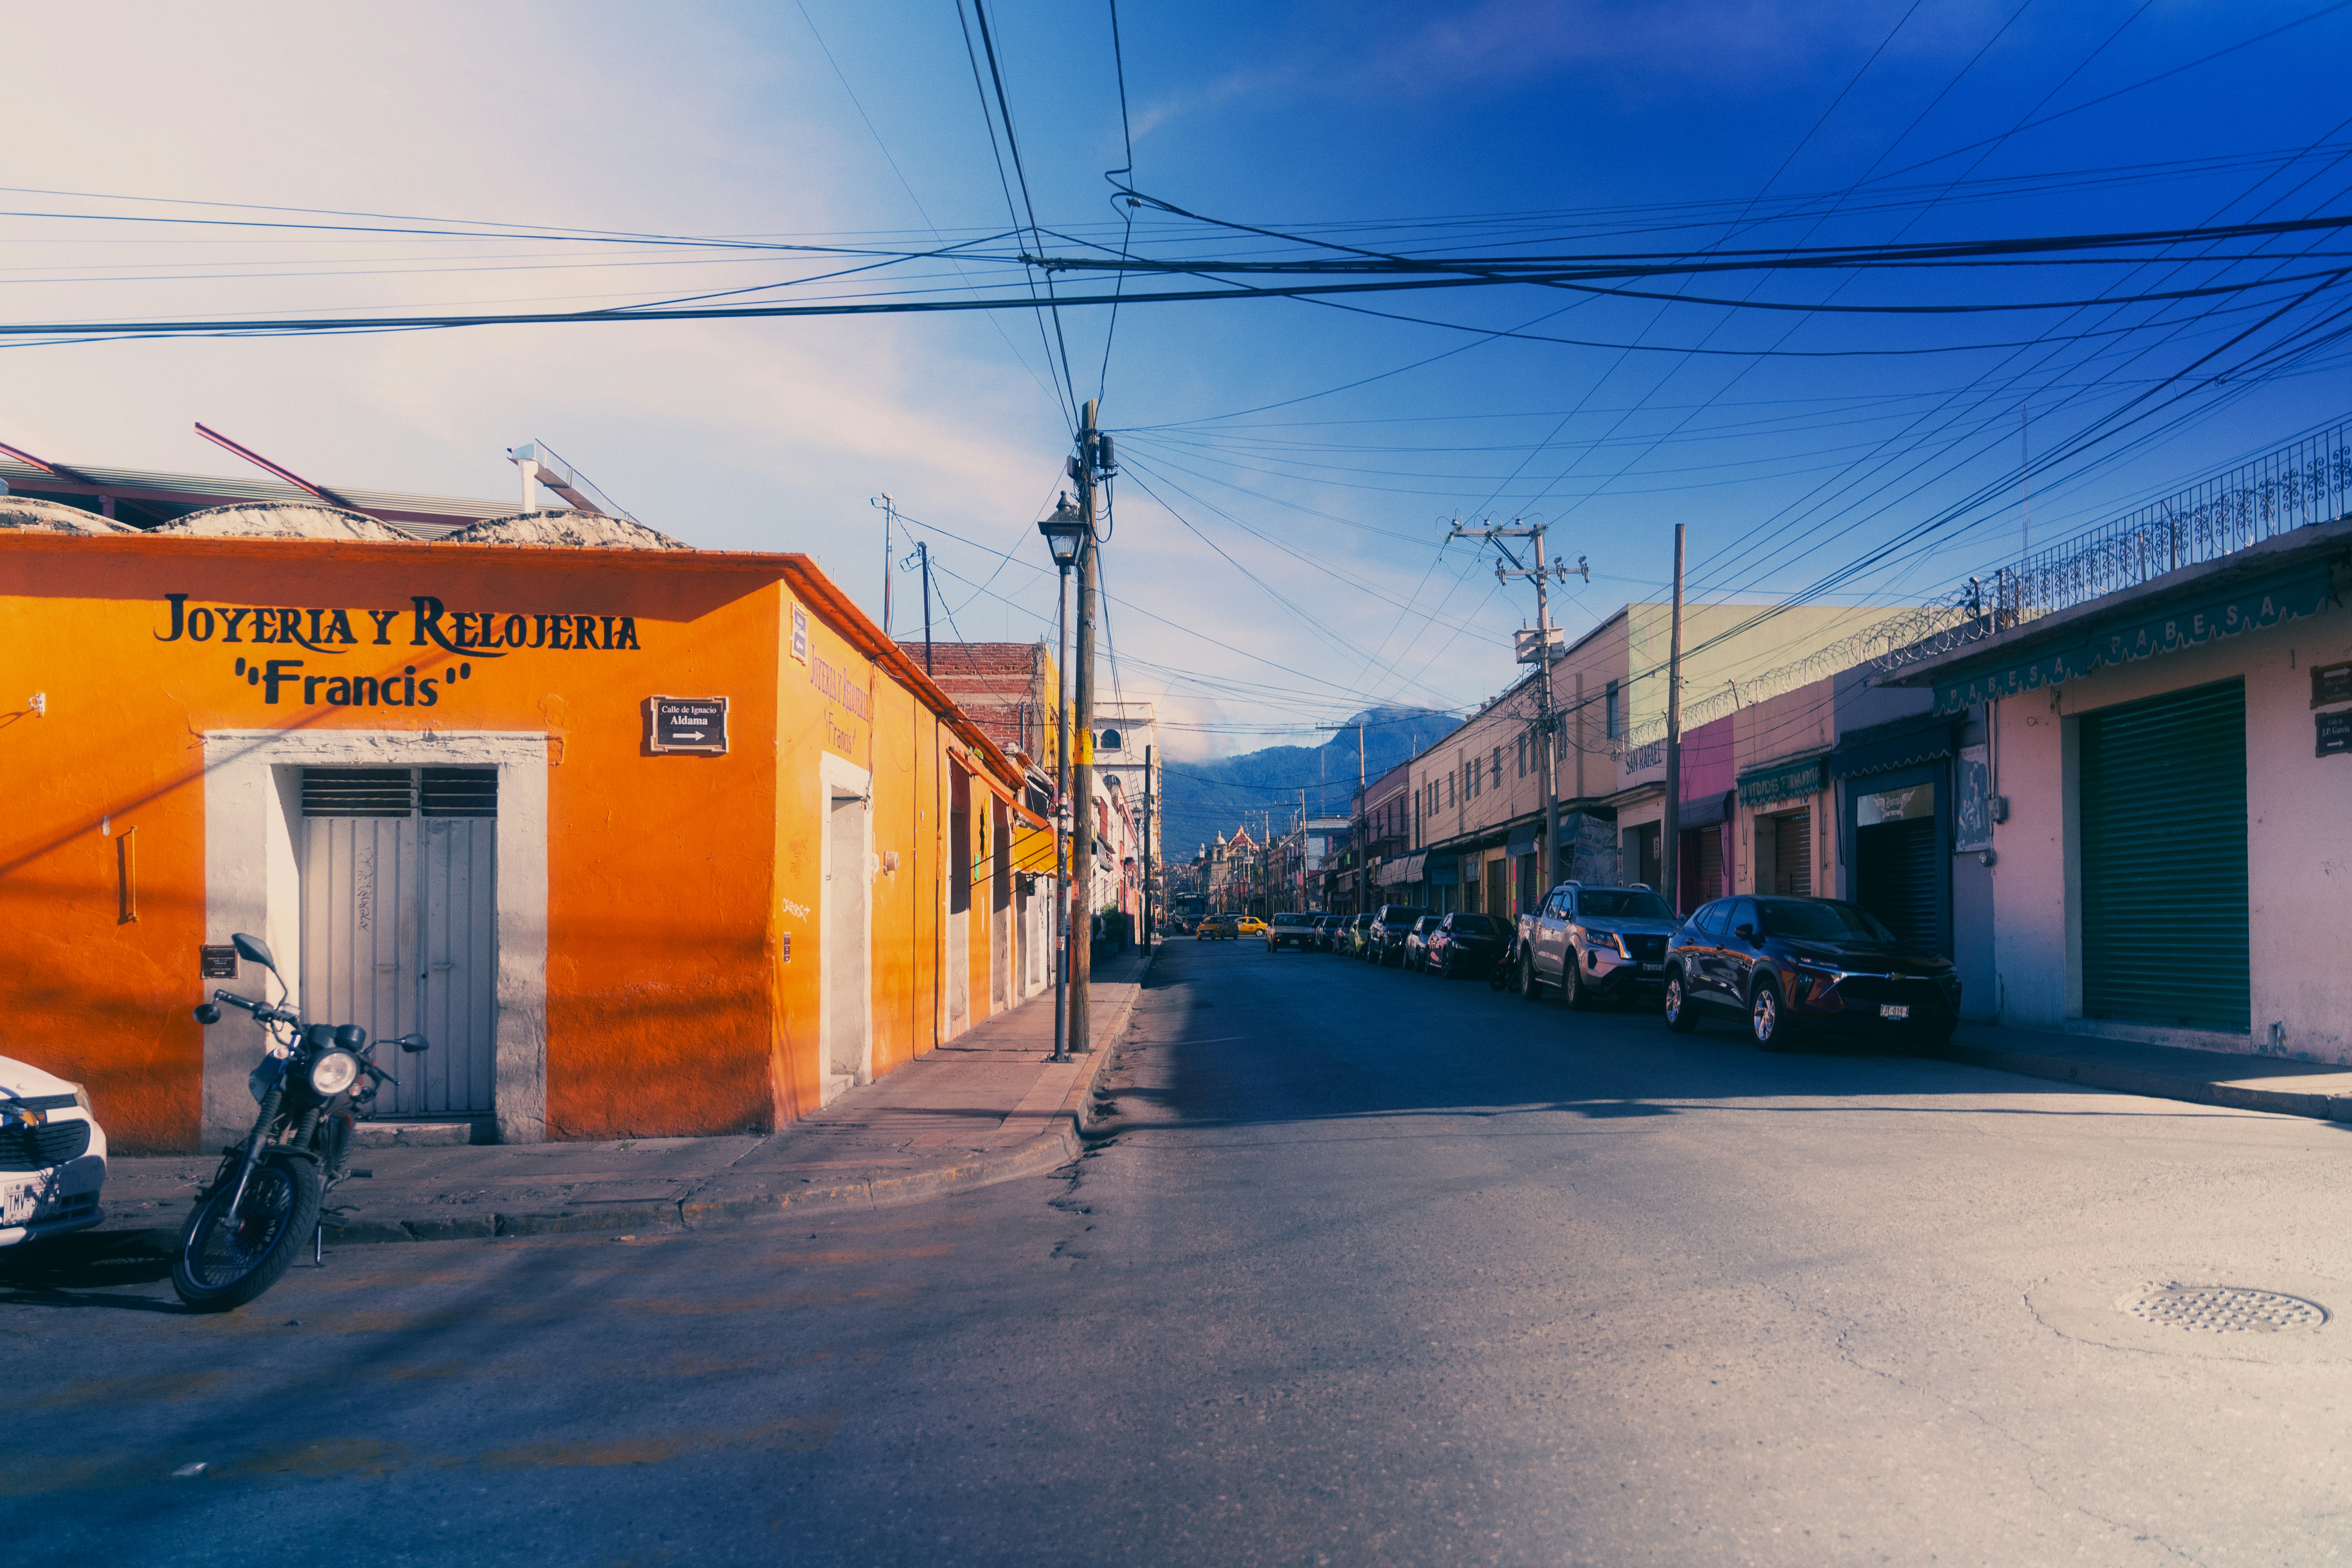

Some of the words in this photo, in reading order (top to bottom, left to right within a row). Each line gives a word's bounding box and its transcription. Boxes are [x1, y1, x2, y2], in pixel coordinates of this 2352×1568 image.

[154, 593, 357, 654] JOYERIA
[369, 609, 399, 645] Y
[409, 595, 641, 658] RELOJERIA
[810, 644, 837, 706] JOYERIA
[838, 673, 842, 703] Y
[670, 715, 708, 725] Aldama
[691, 706, 717, 715] Ignacio
[2322, 728, 2331, 737] J.P.
[2332, 725, 2350, 735] García
[1626, 749, 1638, 775] SAN
[1639, 740, 1662, 770] RAFAEL
